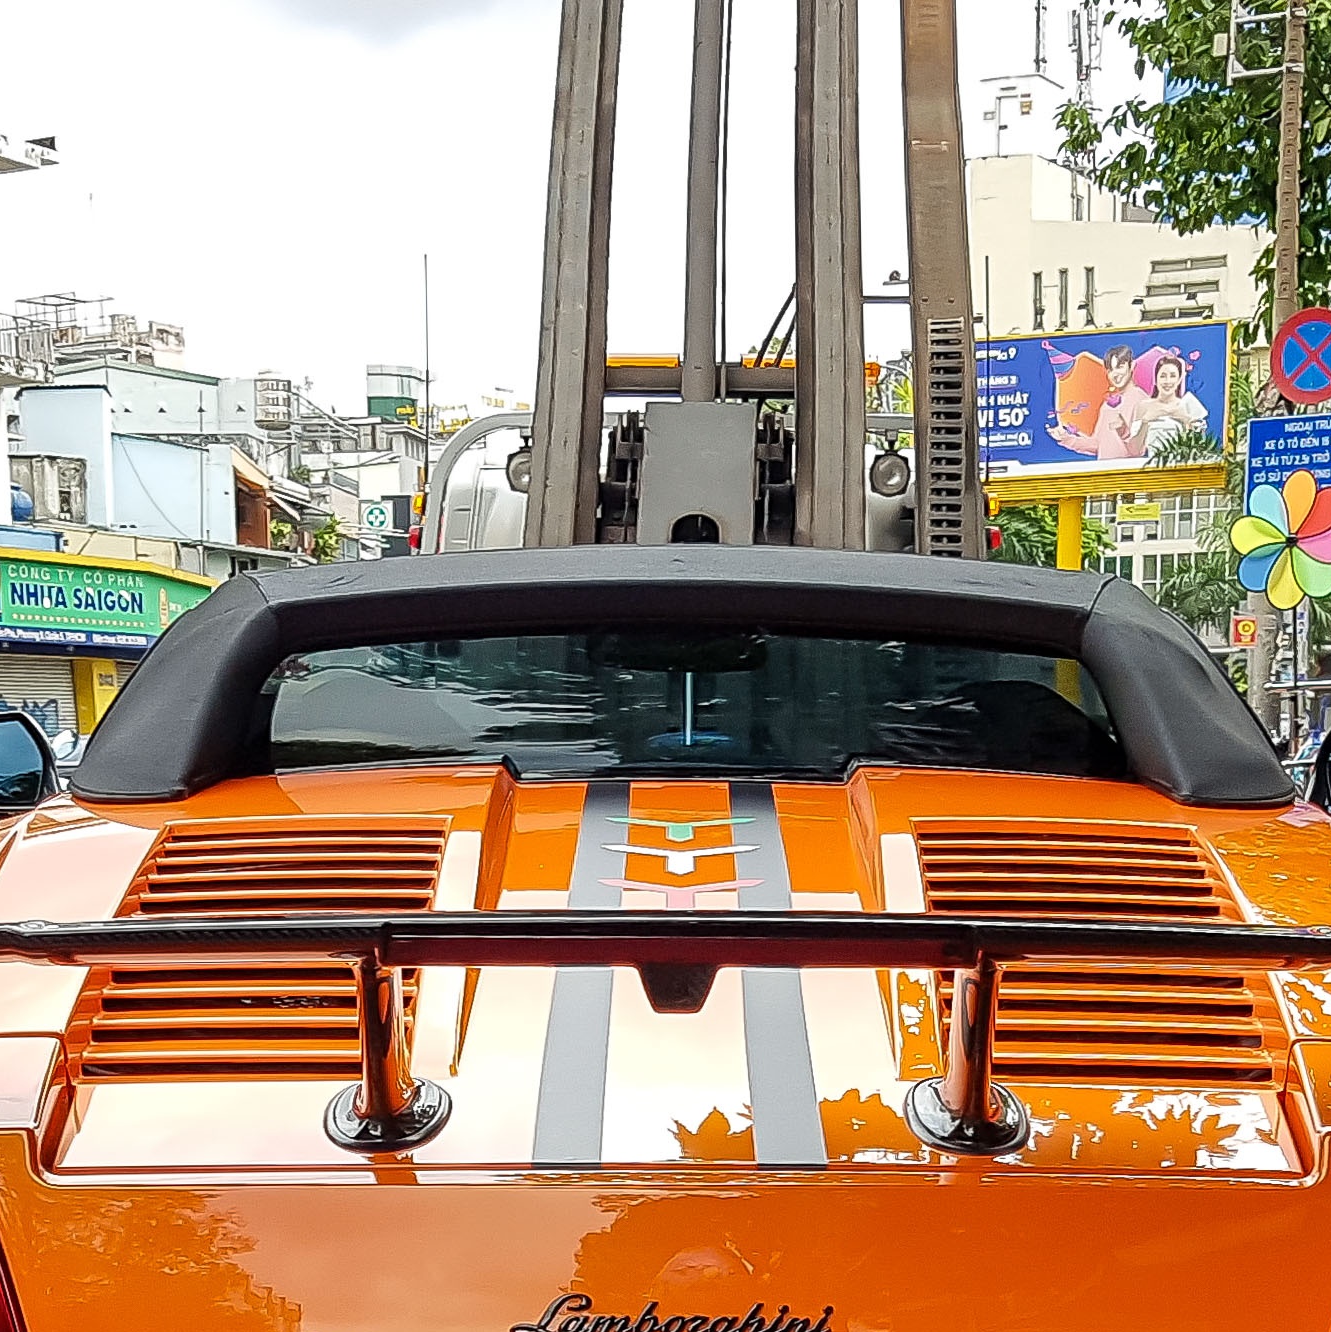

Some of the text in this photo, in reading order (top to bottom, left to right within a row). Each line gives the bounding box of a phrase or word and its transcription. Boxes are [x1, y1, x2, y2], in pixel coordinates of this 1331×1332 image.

[1264, 440, 1276, 450] XE
[1251, 457, 1263, 467] XE
[7, 564, 51, 580] CÔNG
[58, 568, 75, 582] TY
